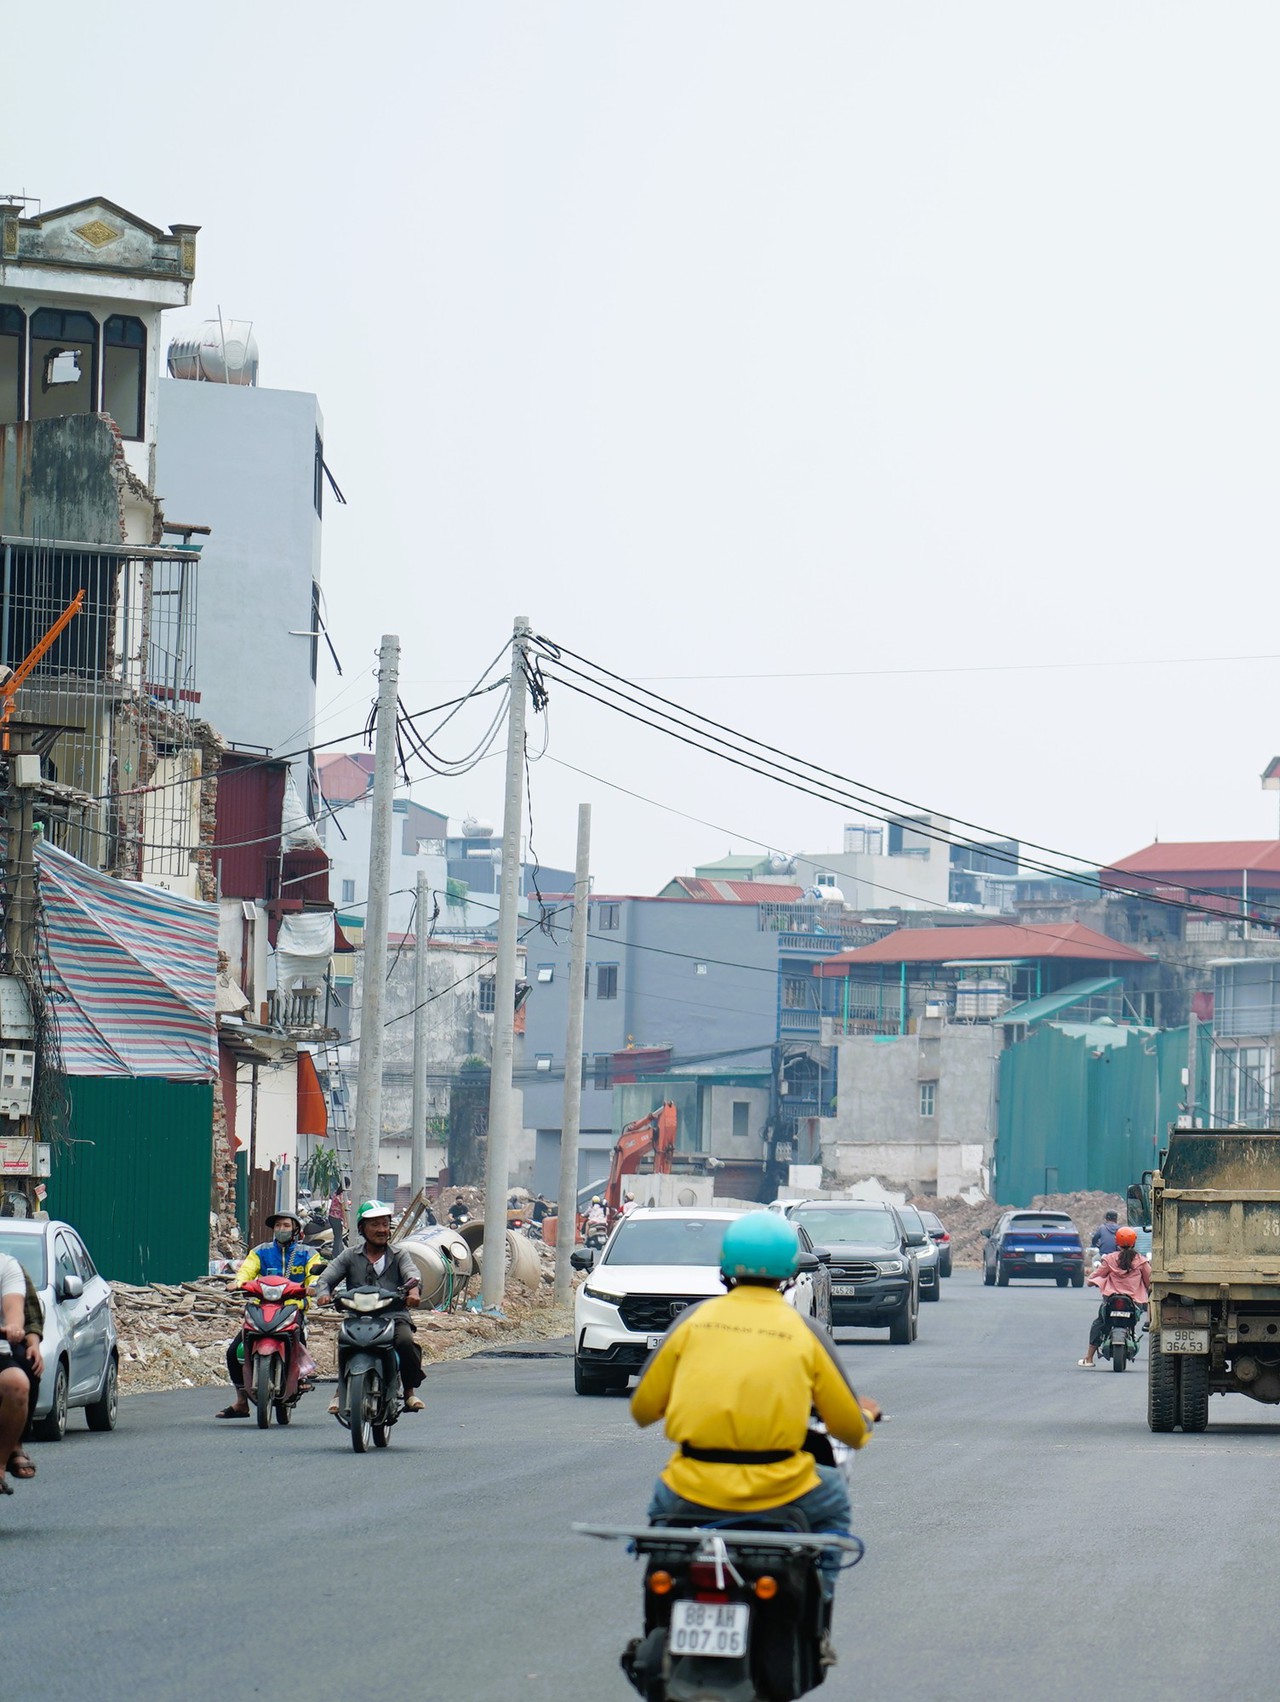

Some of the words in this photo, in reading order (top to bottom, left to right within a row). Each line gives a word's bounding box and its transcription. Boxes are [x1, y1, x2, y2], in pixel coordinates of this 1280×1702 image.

[1174, 1330, 1195, 1341] 98C
[1166, 1341, 1203, 1352] 364.53
[676, 1628, 741, 1651] 007.06
